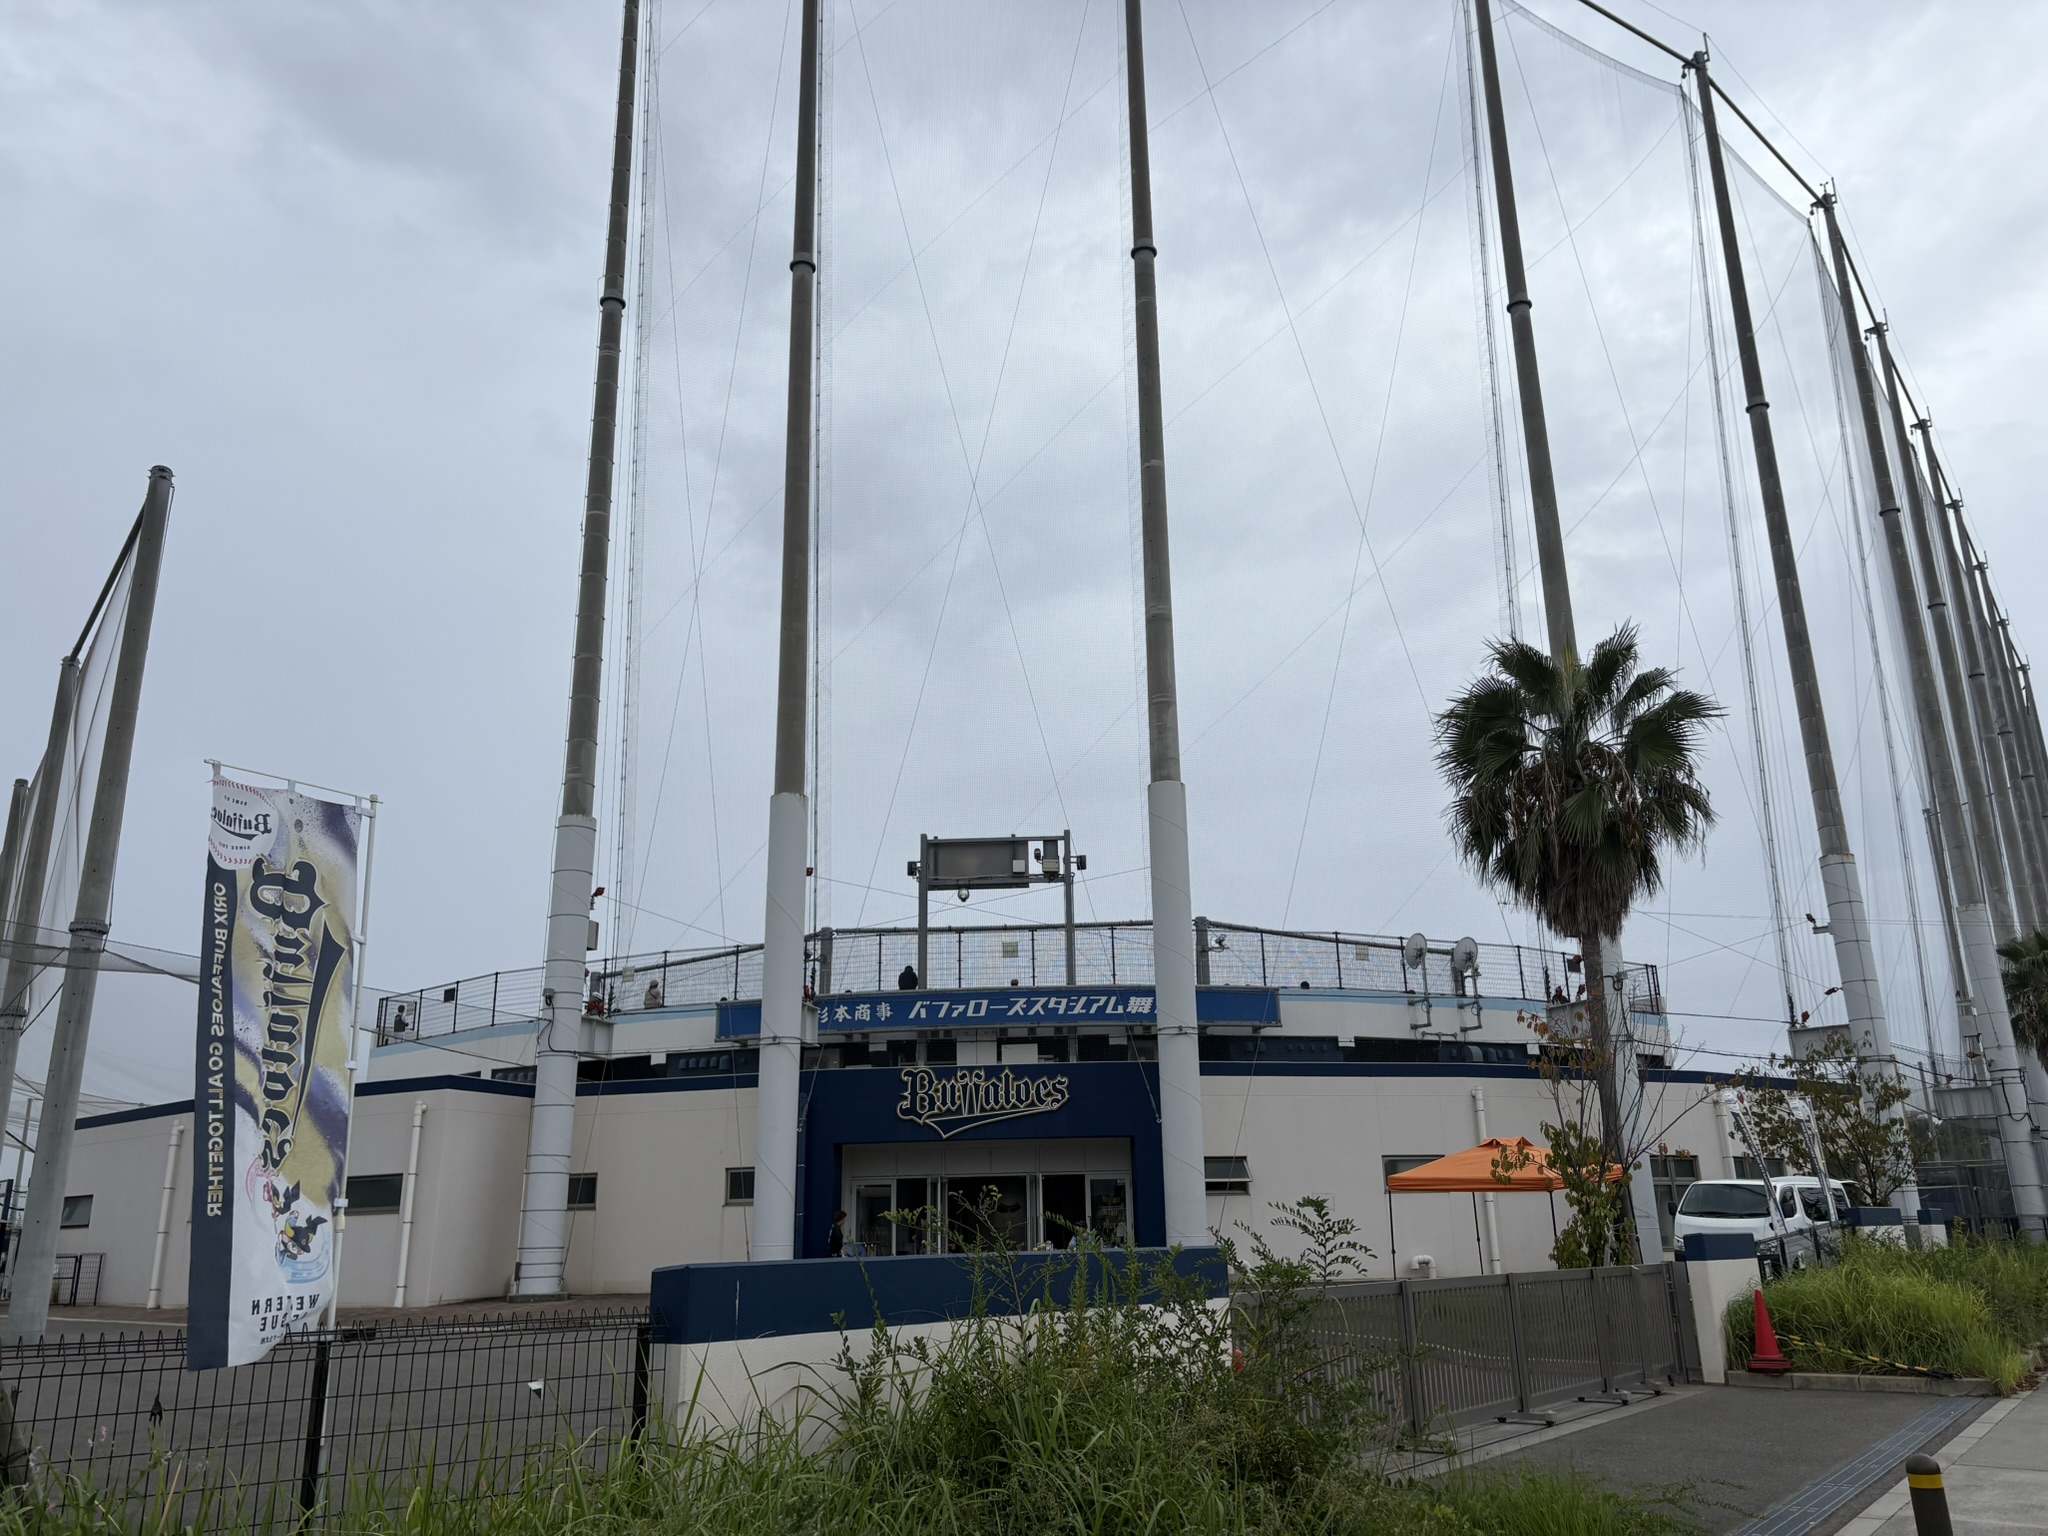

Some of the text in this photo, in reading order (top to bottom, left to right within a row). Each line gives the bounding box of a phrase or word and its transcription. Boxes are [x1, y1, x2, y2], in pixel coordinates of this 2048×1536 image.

[908, 996, 1157, 1019] バファローズスタジアム舞
[896, 1066, 1071, 1128] Buffaloes
